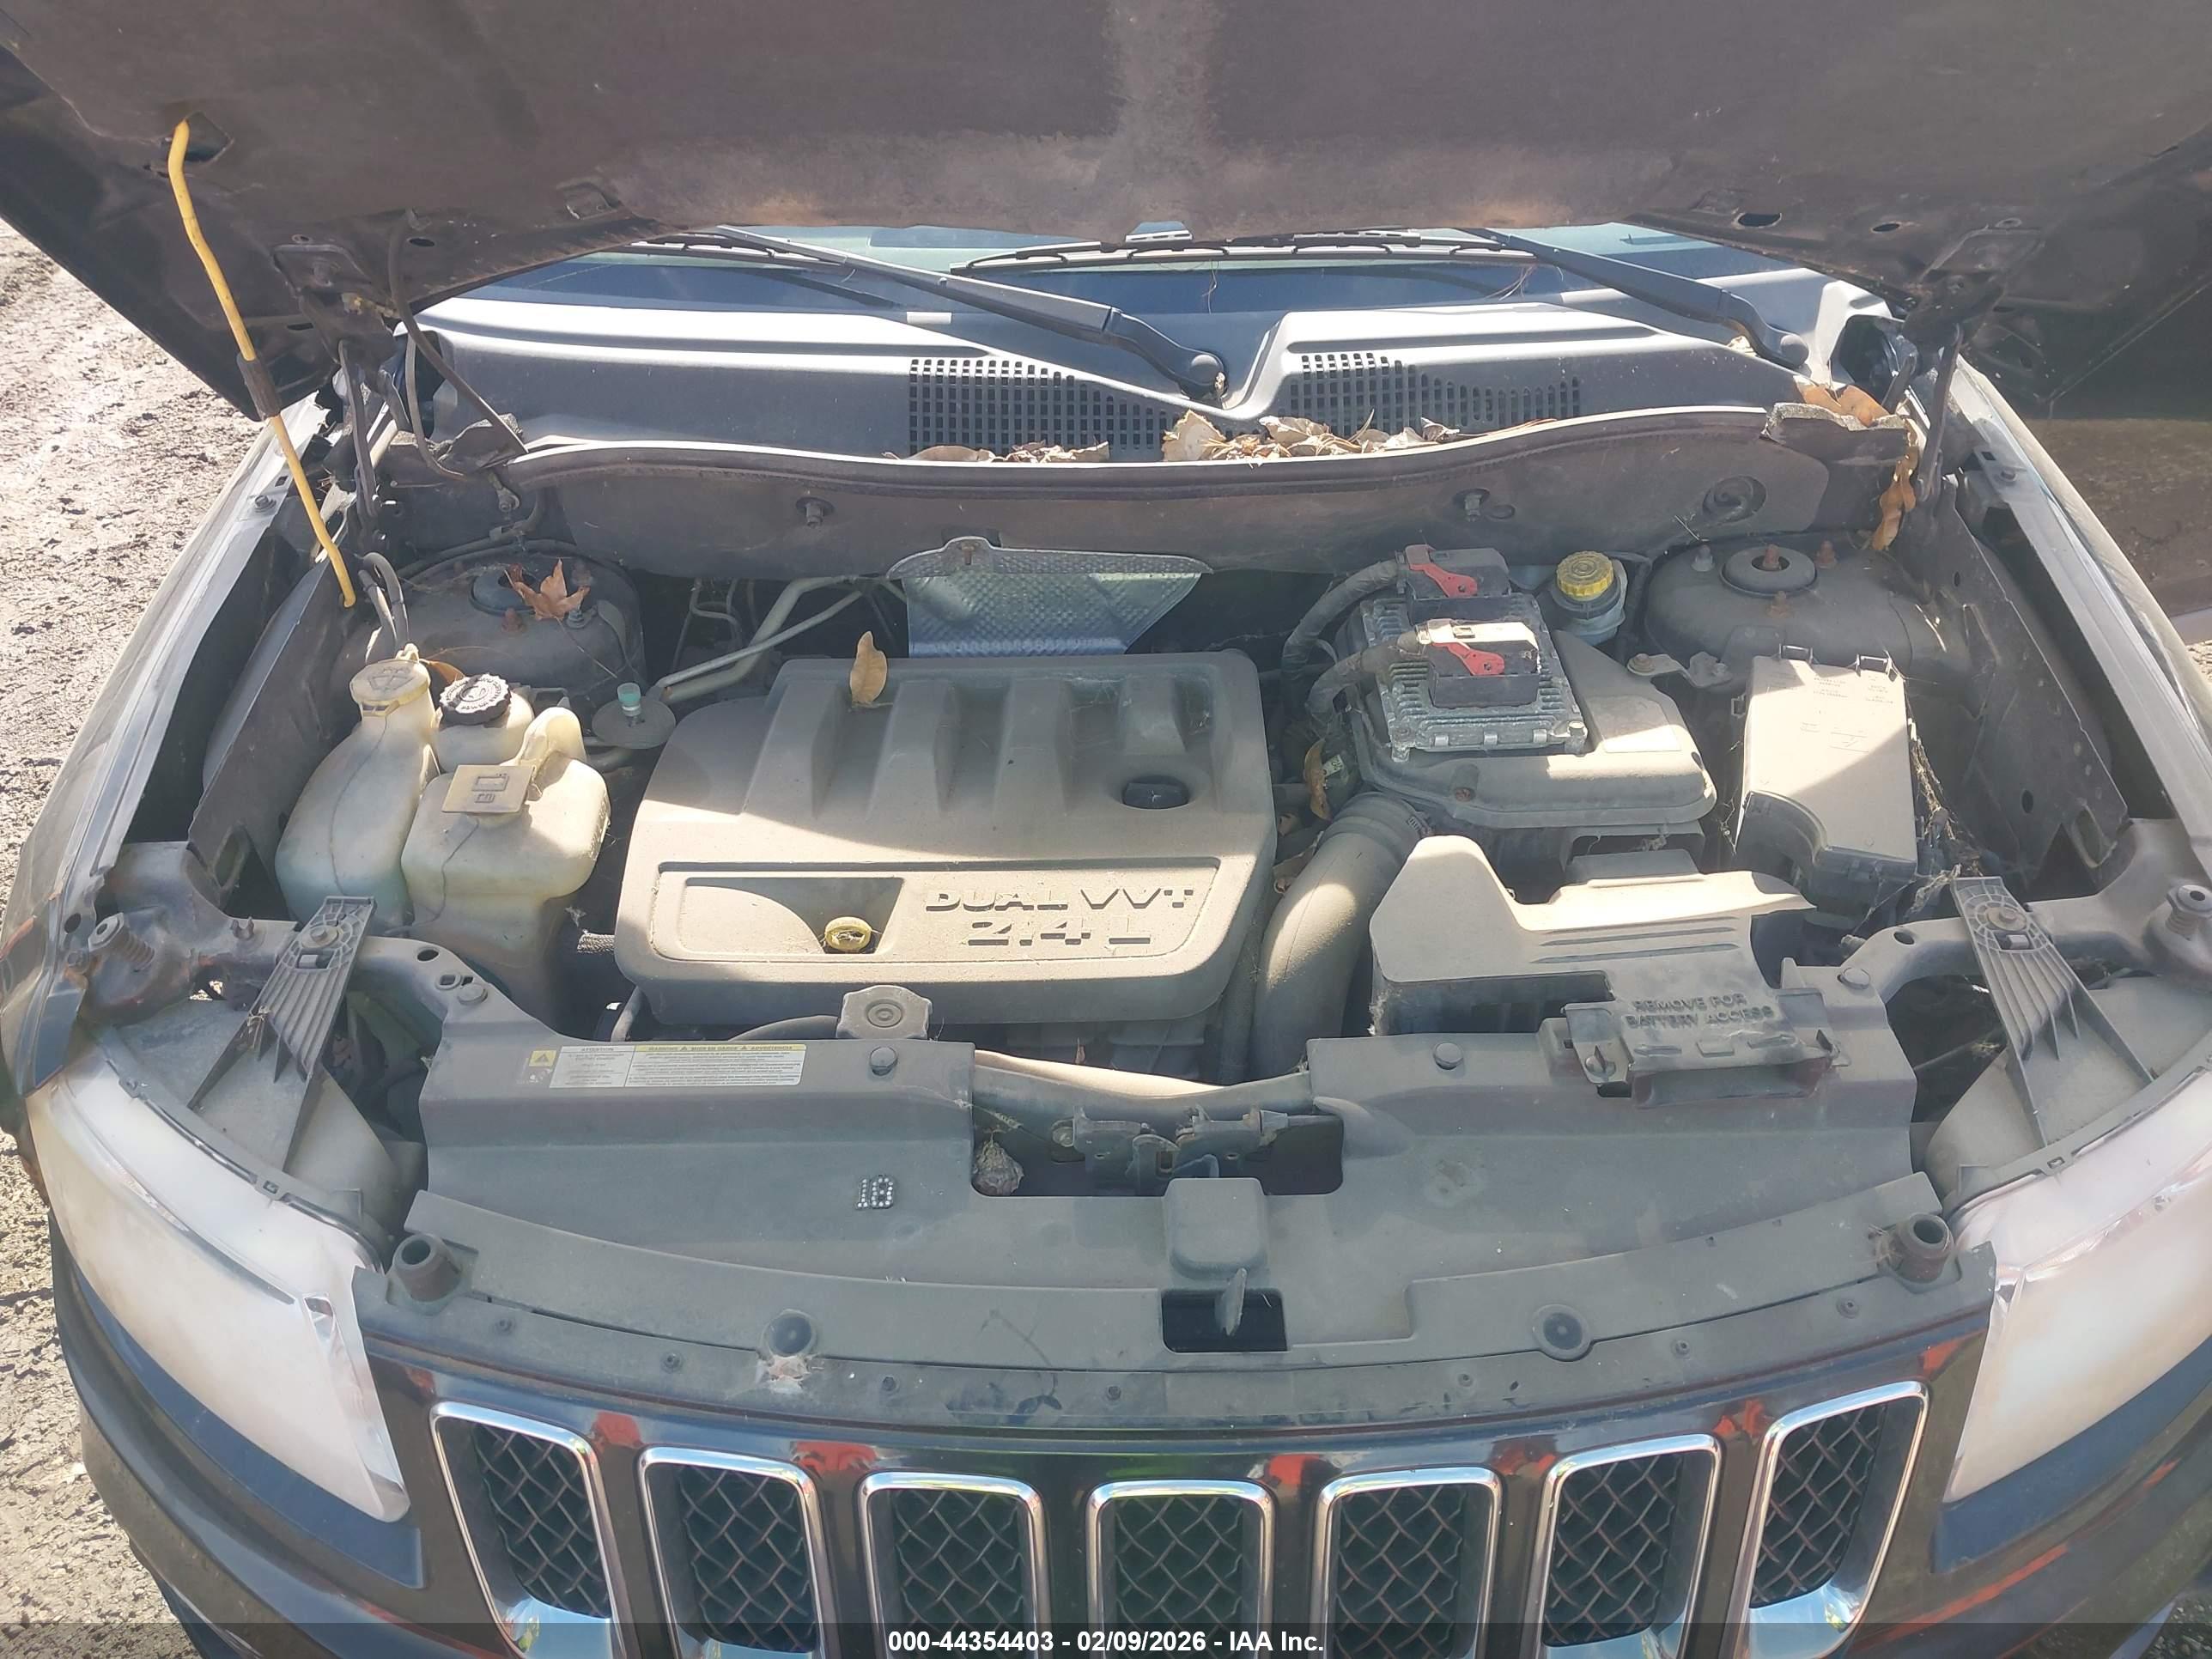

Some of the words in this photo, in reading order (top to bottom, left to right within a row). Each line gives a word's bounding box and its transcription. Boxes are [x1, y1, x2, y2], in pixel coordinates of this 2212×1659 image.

[926, 890, 1069, 912] DUAL
[1079, 887, 1194, 910] VVT
[1632, 997, 1707, 1013] REMOVE
[1710, 993, 1748, 1008] FOR
[1625, 1013, 1699, 1030] BATTERY
[1707, 1005, 1775, 1025] ACCESS
